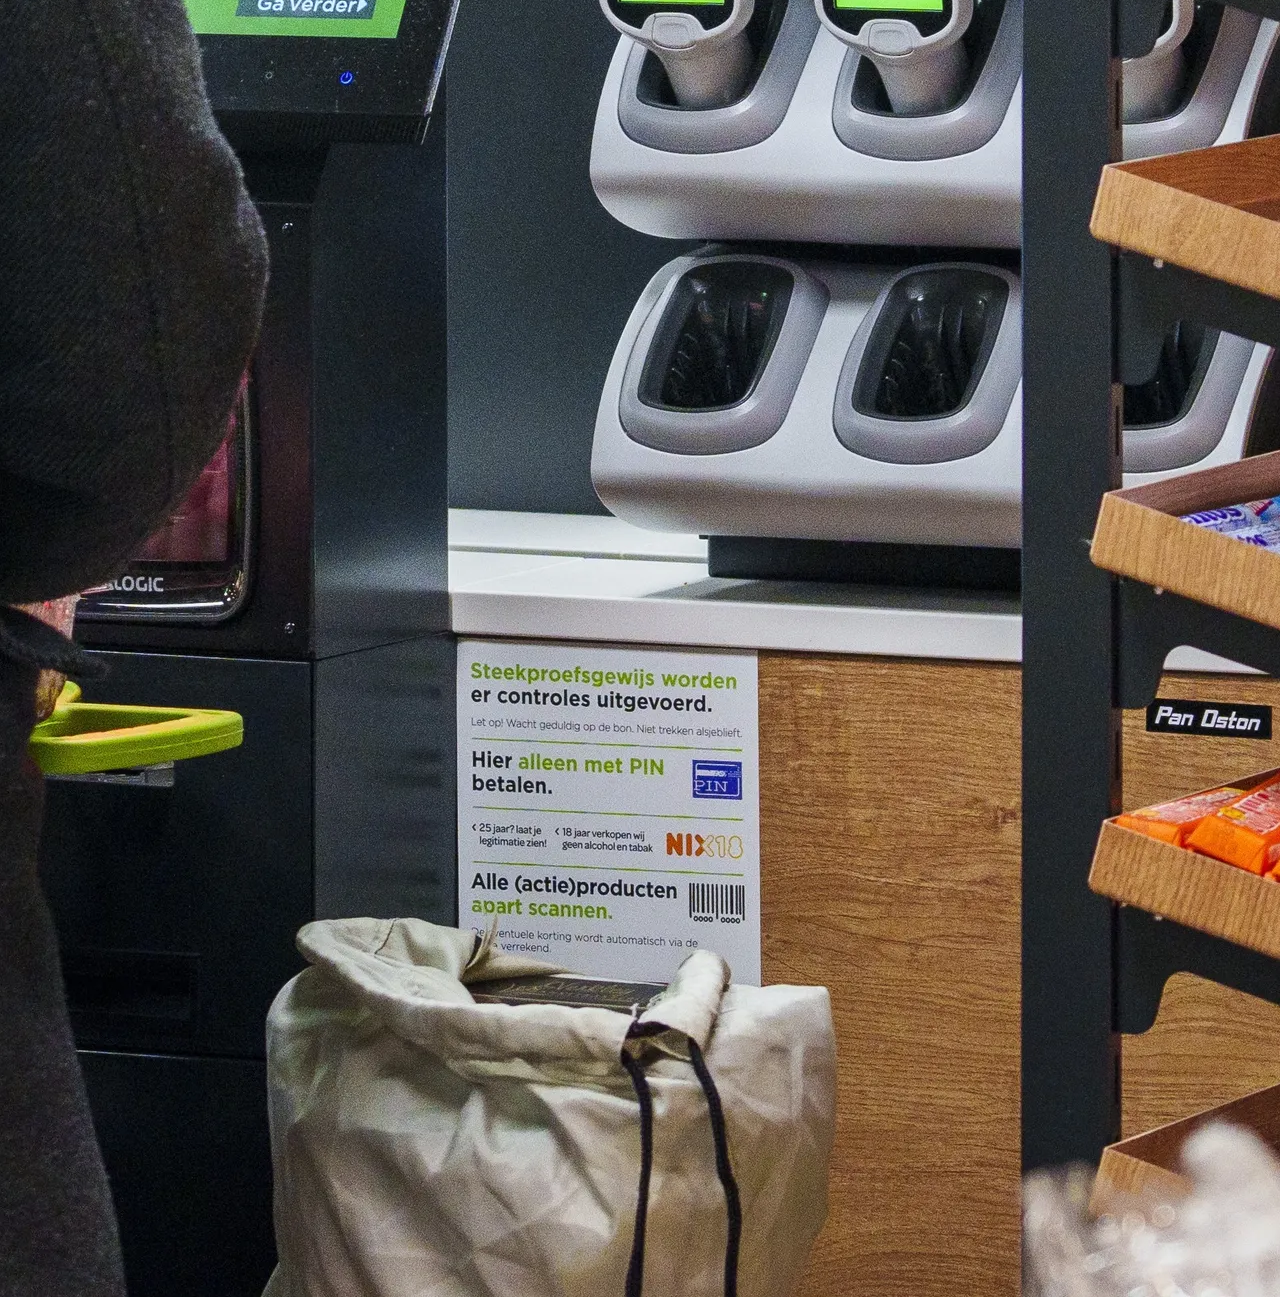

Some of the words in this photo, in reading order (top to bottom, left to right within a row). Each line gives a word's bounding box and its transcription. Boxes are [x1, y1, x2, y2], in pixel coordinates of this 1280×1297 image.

[107, 575, 164, 592] LOGIC
[471, 662, 655, 690] Steekproefsgewijs
[662, 672, 738, 690] worden
[472, 689, 491, 703] er
[497, 690, 590, 708] controles
[597, 691, 713, 713] uitgevoerd.
[1155, 706, 1194, 726] Pan
[471, 718, 486, 728] Let
[488, 718, 504, 730] op!
[506, 718, 537, 730] Wacht
[539, 720, 580, 733] geduldig
[584, 724, 596, 734] op
[598, 722, 611, 732] de
[613, 722, 634, 734] bon.
[636, 724, 656, 734] Niet
[658, 725, 694, 736] trekken
[696, 727, 743, 738] alsjeblieft.
[472, 751, 513, 770] Hier
[518, 754, 578, 772] alleen
[584, 758, 624, 774] met
[629, 758, 665, 776] PIN
[472, 774, 553, 795] betalen.
[694, 779, 728, 792] PIN
[479, 824, 492, 833] 25
[492, 824, 514, 834] jaar?
[516, 825, 530, 835] laat
[531, 826, 542, 836] je
[562, 828, 572, 837] 18
[572, 828, 590, 838] jaar
[592, 830, 632, 842] verkopen
[632, 832, 645, 842] wij
[480, 836, 525, 848] legitimatie
[526, 838, 547, 848] zien!
[562, 841, 583, 851] geen
[584, 840, 616, 852] alcohol
[616, 844, 627, 852] en
[628, 842, 654, 853] tabak
[666, 832, 744, 858] NIX18
[471, 873, 508, 891] Alle
[514, 874, 678, 899] (actie)producten
[528, 901, 613, 920] scannen.
[500, 942, 552, 954] verrekend.
[537, 930, 572, 942] korting
[574, 933, 604, 944] wordt
[606, 934, 666, 946] automatisch
[668, 938, 682, 948] via
[685, 938, 698, 948] de
